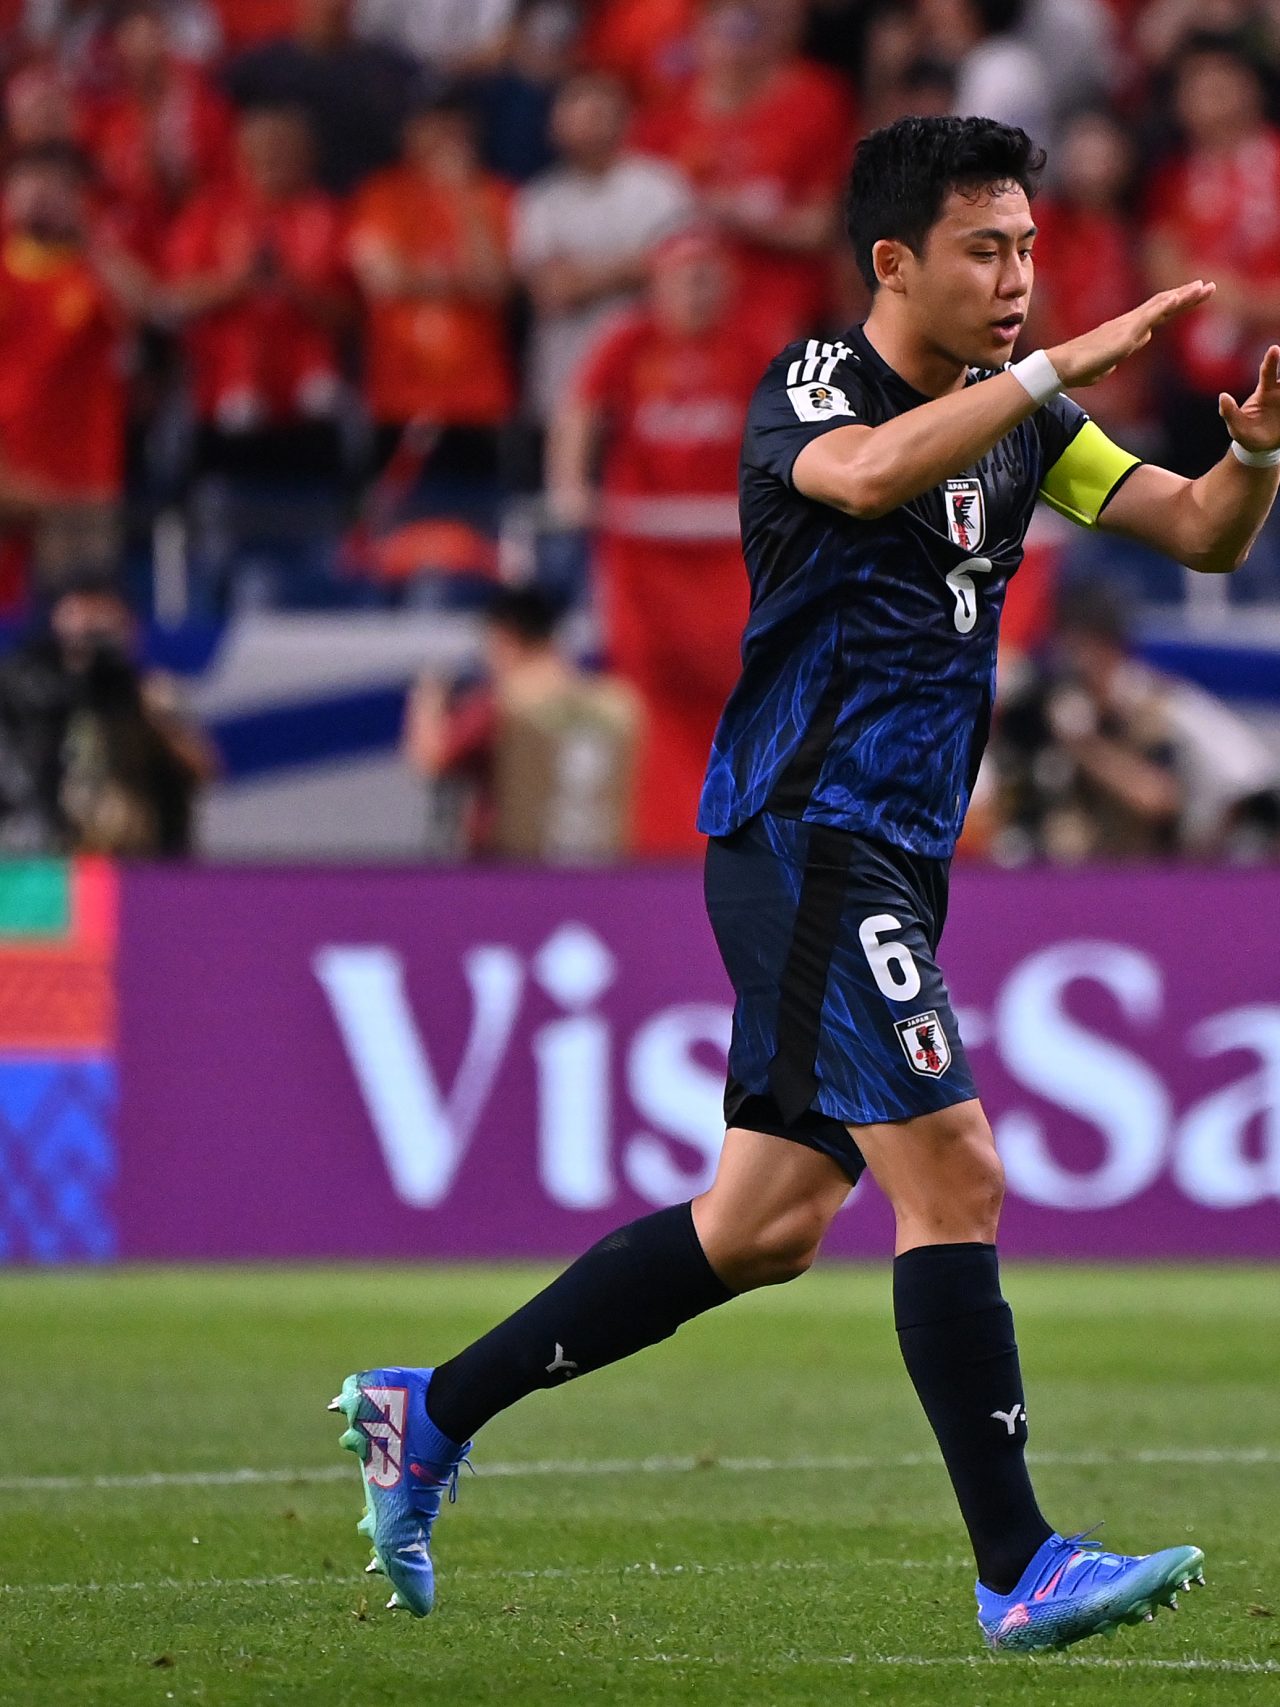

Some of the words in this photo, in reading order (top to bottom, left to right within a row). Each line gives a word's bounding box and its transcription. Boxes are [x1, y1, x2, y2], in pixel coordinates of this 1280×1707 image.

[946, 557, 993, 634] 6
[858, 913, 921, 1002] 6
[907, 1015, 929, 1028] JAPAN
[990, 1403, 1028, 1436] Y-
